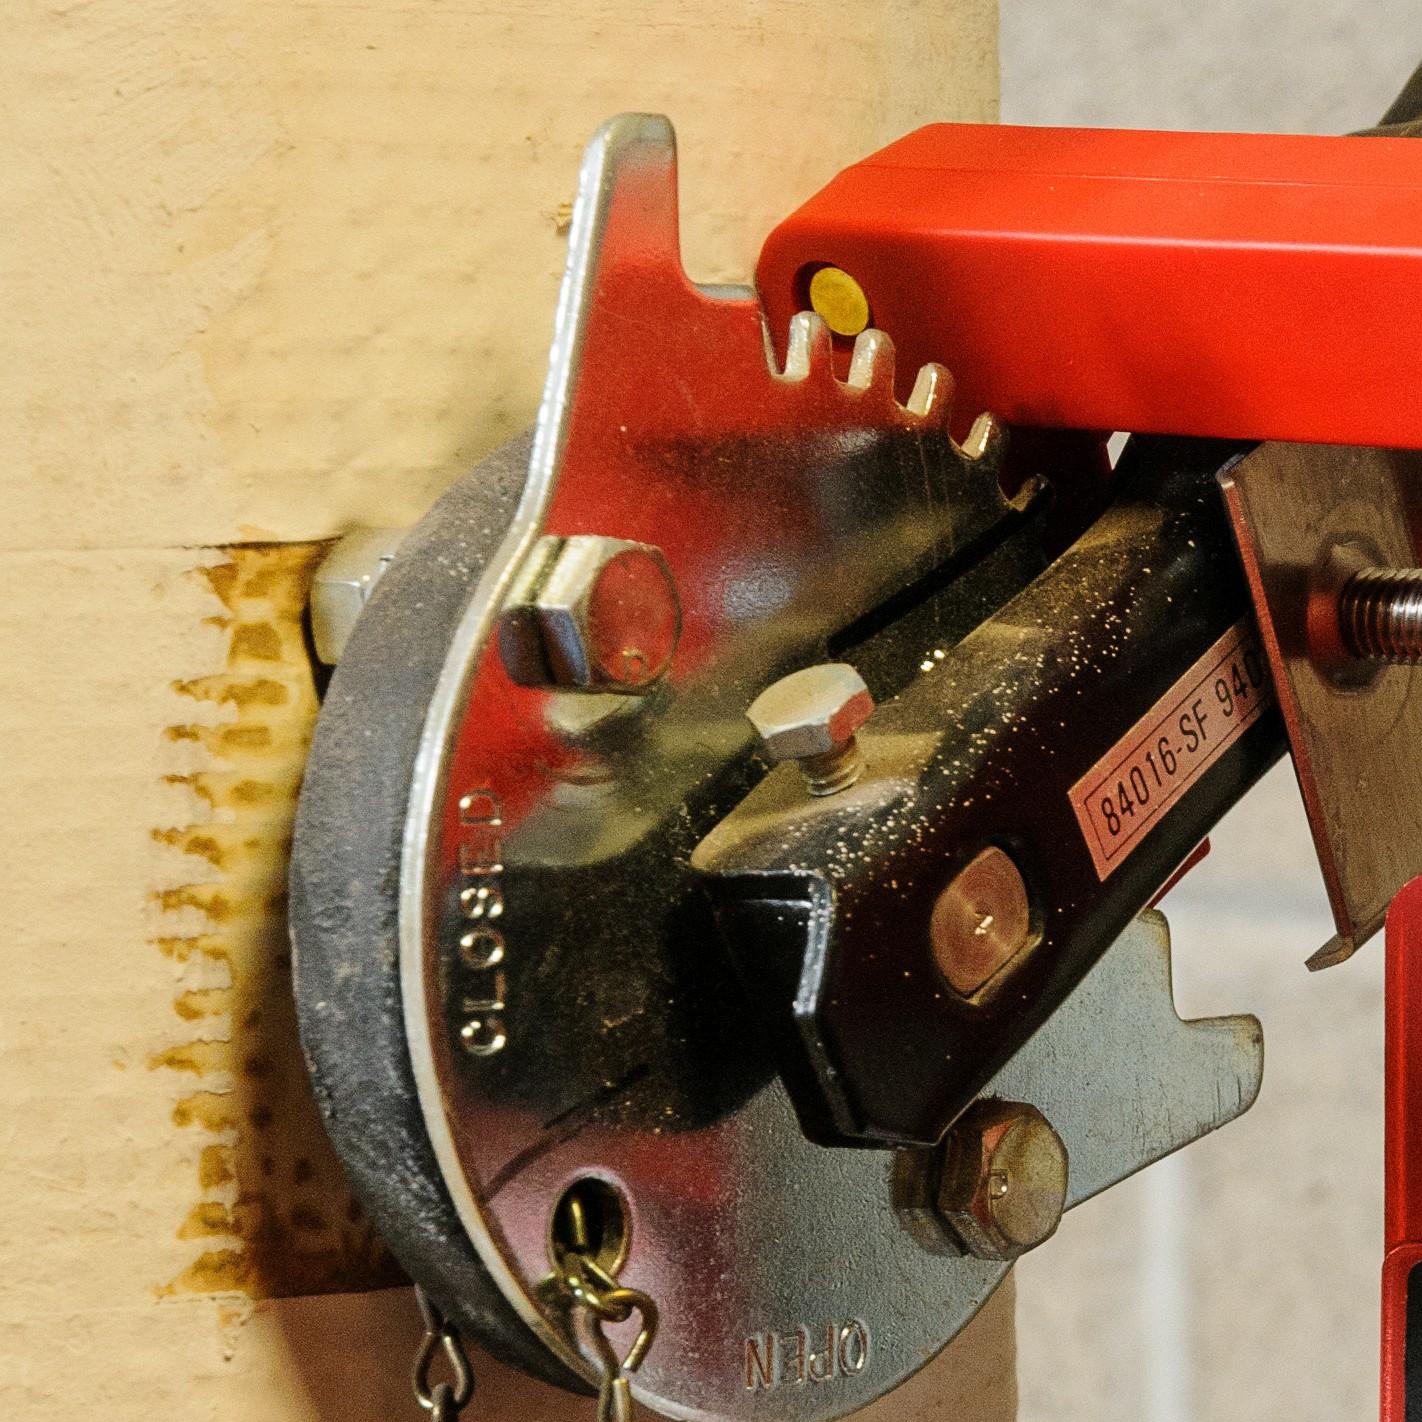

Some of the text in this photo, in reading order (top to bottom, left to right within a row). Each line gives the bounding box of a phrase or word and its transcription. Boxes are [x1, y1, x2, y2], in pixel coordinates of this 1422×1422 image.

[1101, 699, 1208, 836] 84016-SF
[459, 787, 506, 1057] CLOSED
[744, 1318, 870, 1391] OPEN
